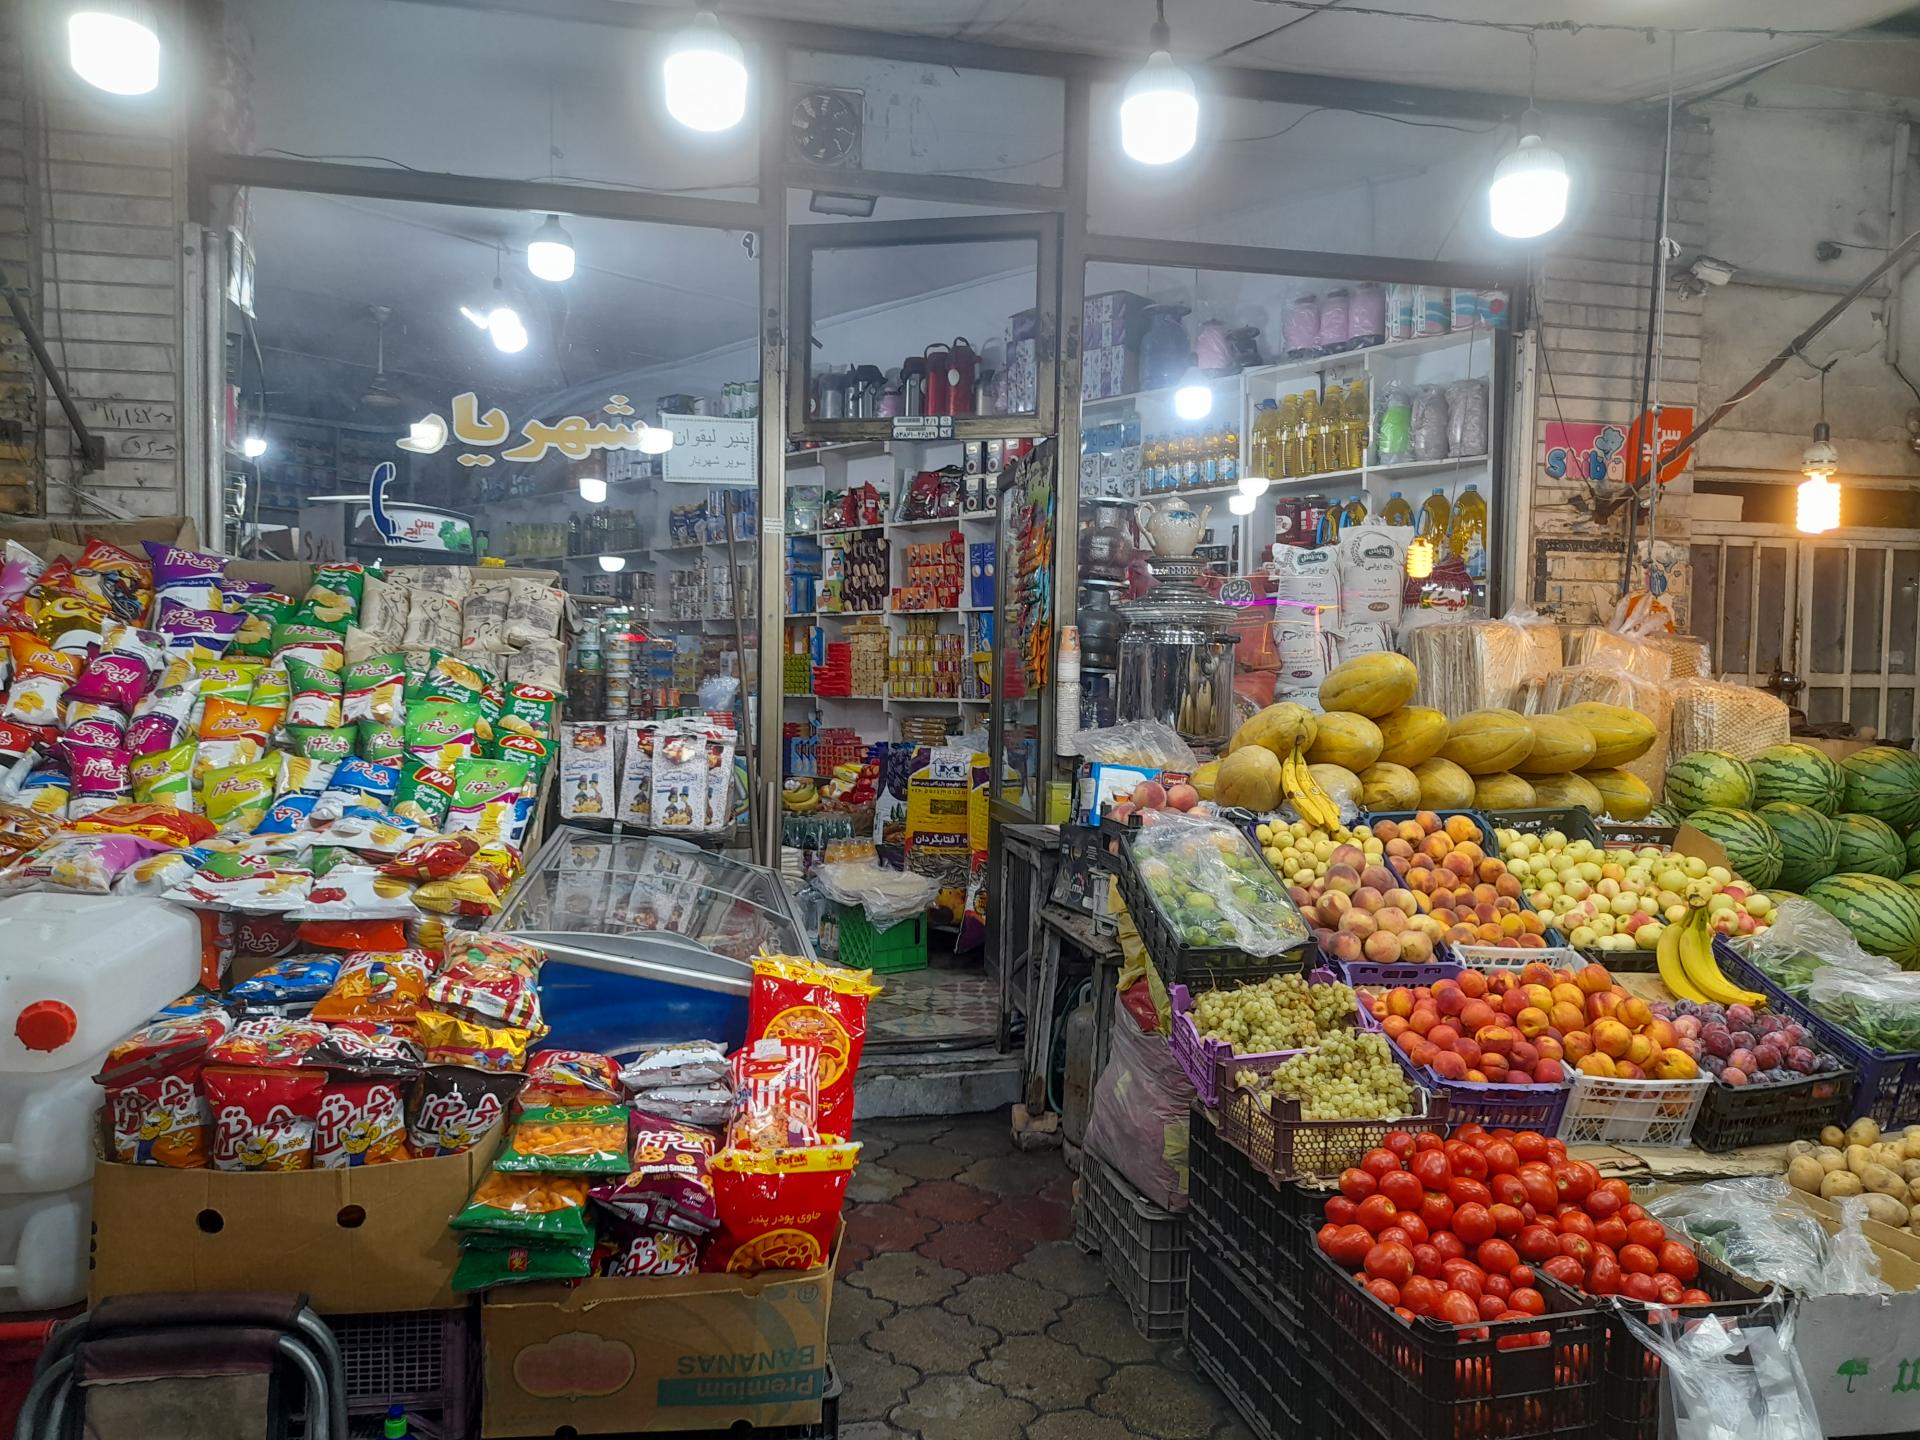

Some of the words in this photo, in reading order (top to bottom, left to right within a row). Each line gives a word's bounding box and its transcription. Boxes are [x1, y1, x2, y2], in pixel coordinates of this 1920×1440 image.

[396, 391, 674, 468] شهریار
[674, 427, 717, 455] لیقوان
[722, 430, 751, 459] پنیر
[688, 455, 720, 467] شهریار
[1546, 446, 1626, 482] Shiba
[914, 833, 961, 847] آفتابگردان
[775, 1152, 808, 1165] Pofak
[640, 1164, 667, 1174] Wheel
[668, 1163, 699, 1175] Snacks
[653, 1172, 671, 1182] With
[747, 1212, 770, 1227] پنیر
[771, 1214, 796, 1226] پودر
[797, 1210, 822, 1225] حاوی
[678, 1345, 816, 1375] BANANAS
[696, 1372, 814, 1400] Premium
